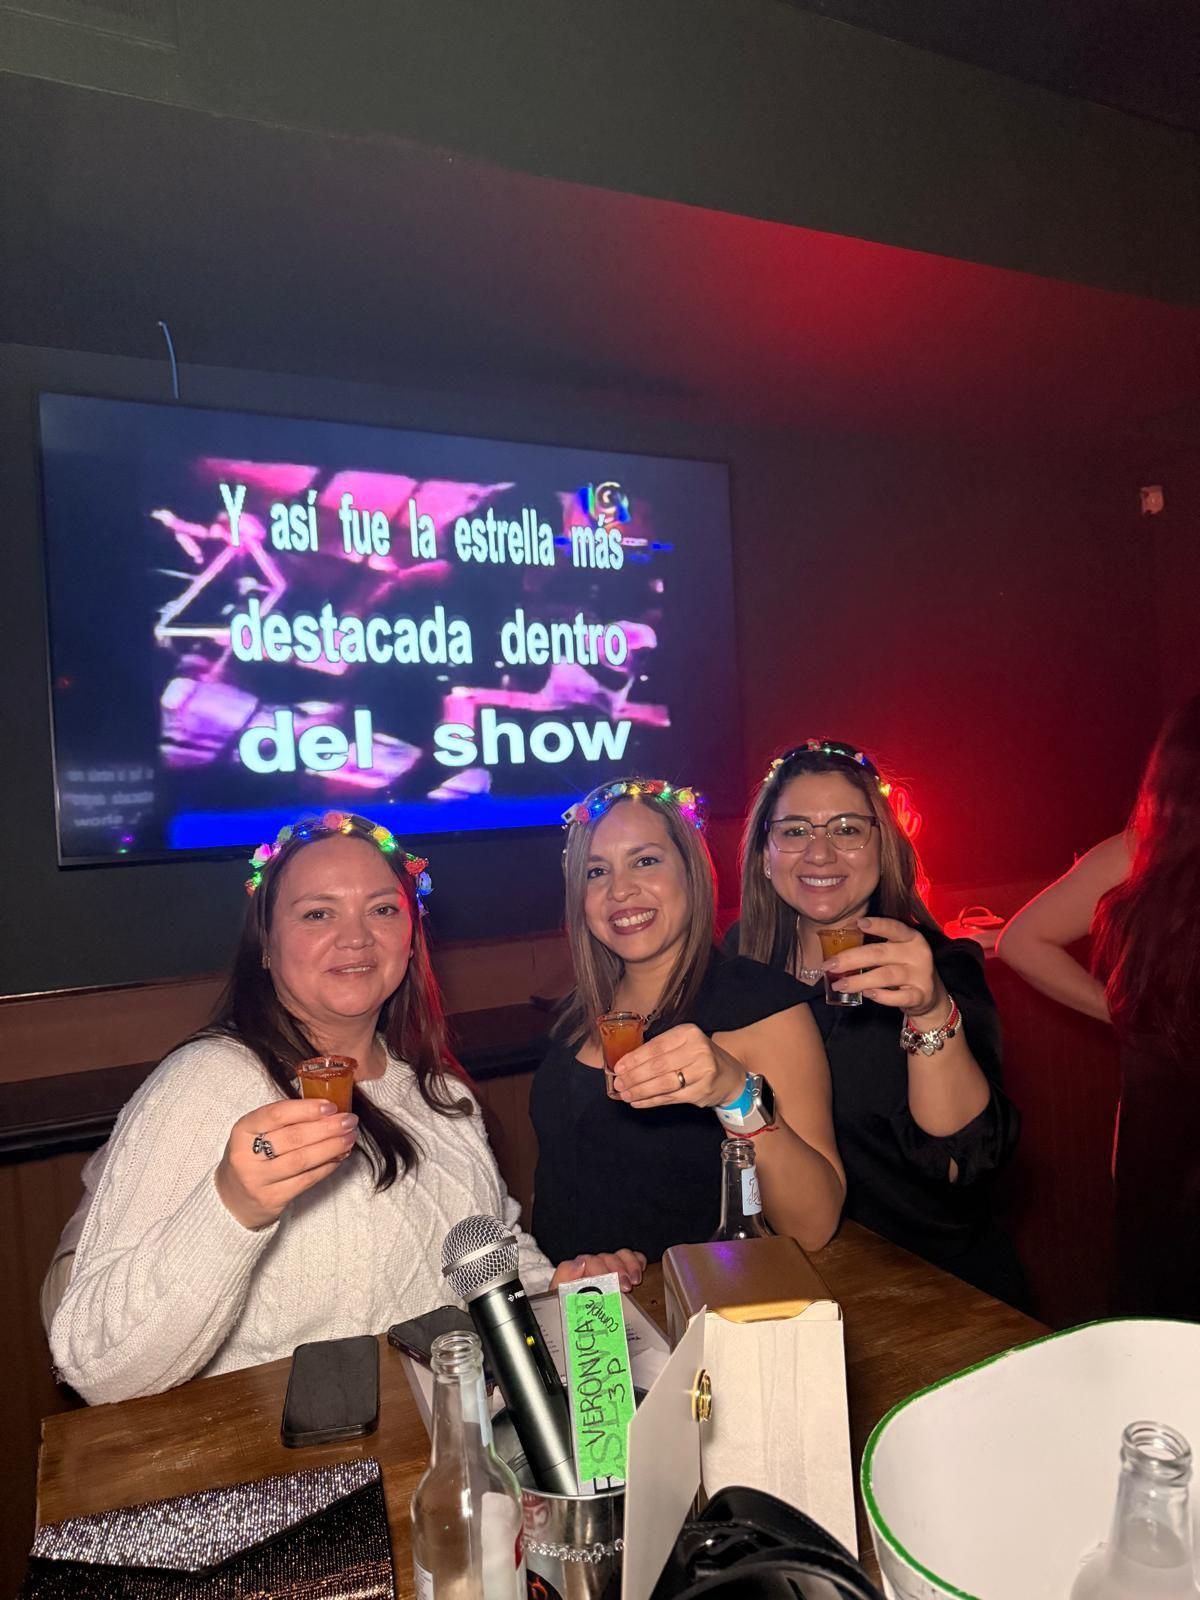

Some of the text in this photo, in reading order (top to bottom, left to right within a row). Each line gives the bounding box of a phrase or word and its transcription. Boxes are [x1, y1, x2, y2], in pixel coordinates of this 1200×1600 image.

[219, 483, 624, 570] Y así fue la estrella más
[231, 598, 628, 666] destacada dentro
[239, 708, 632, 773] del show
[574, 1319, 605, 1447] VERONICA
